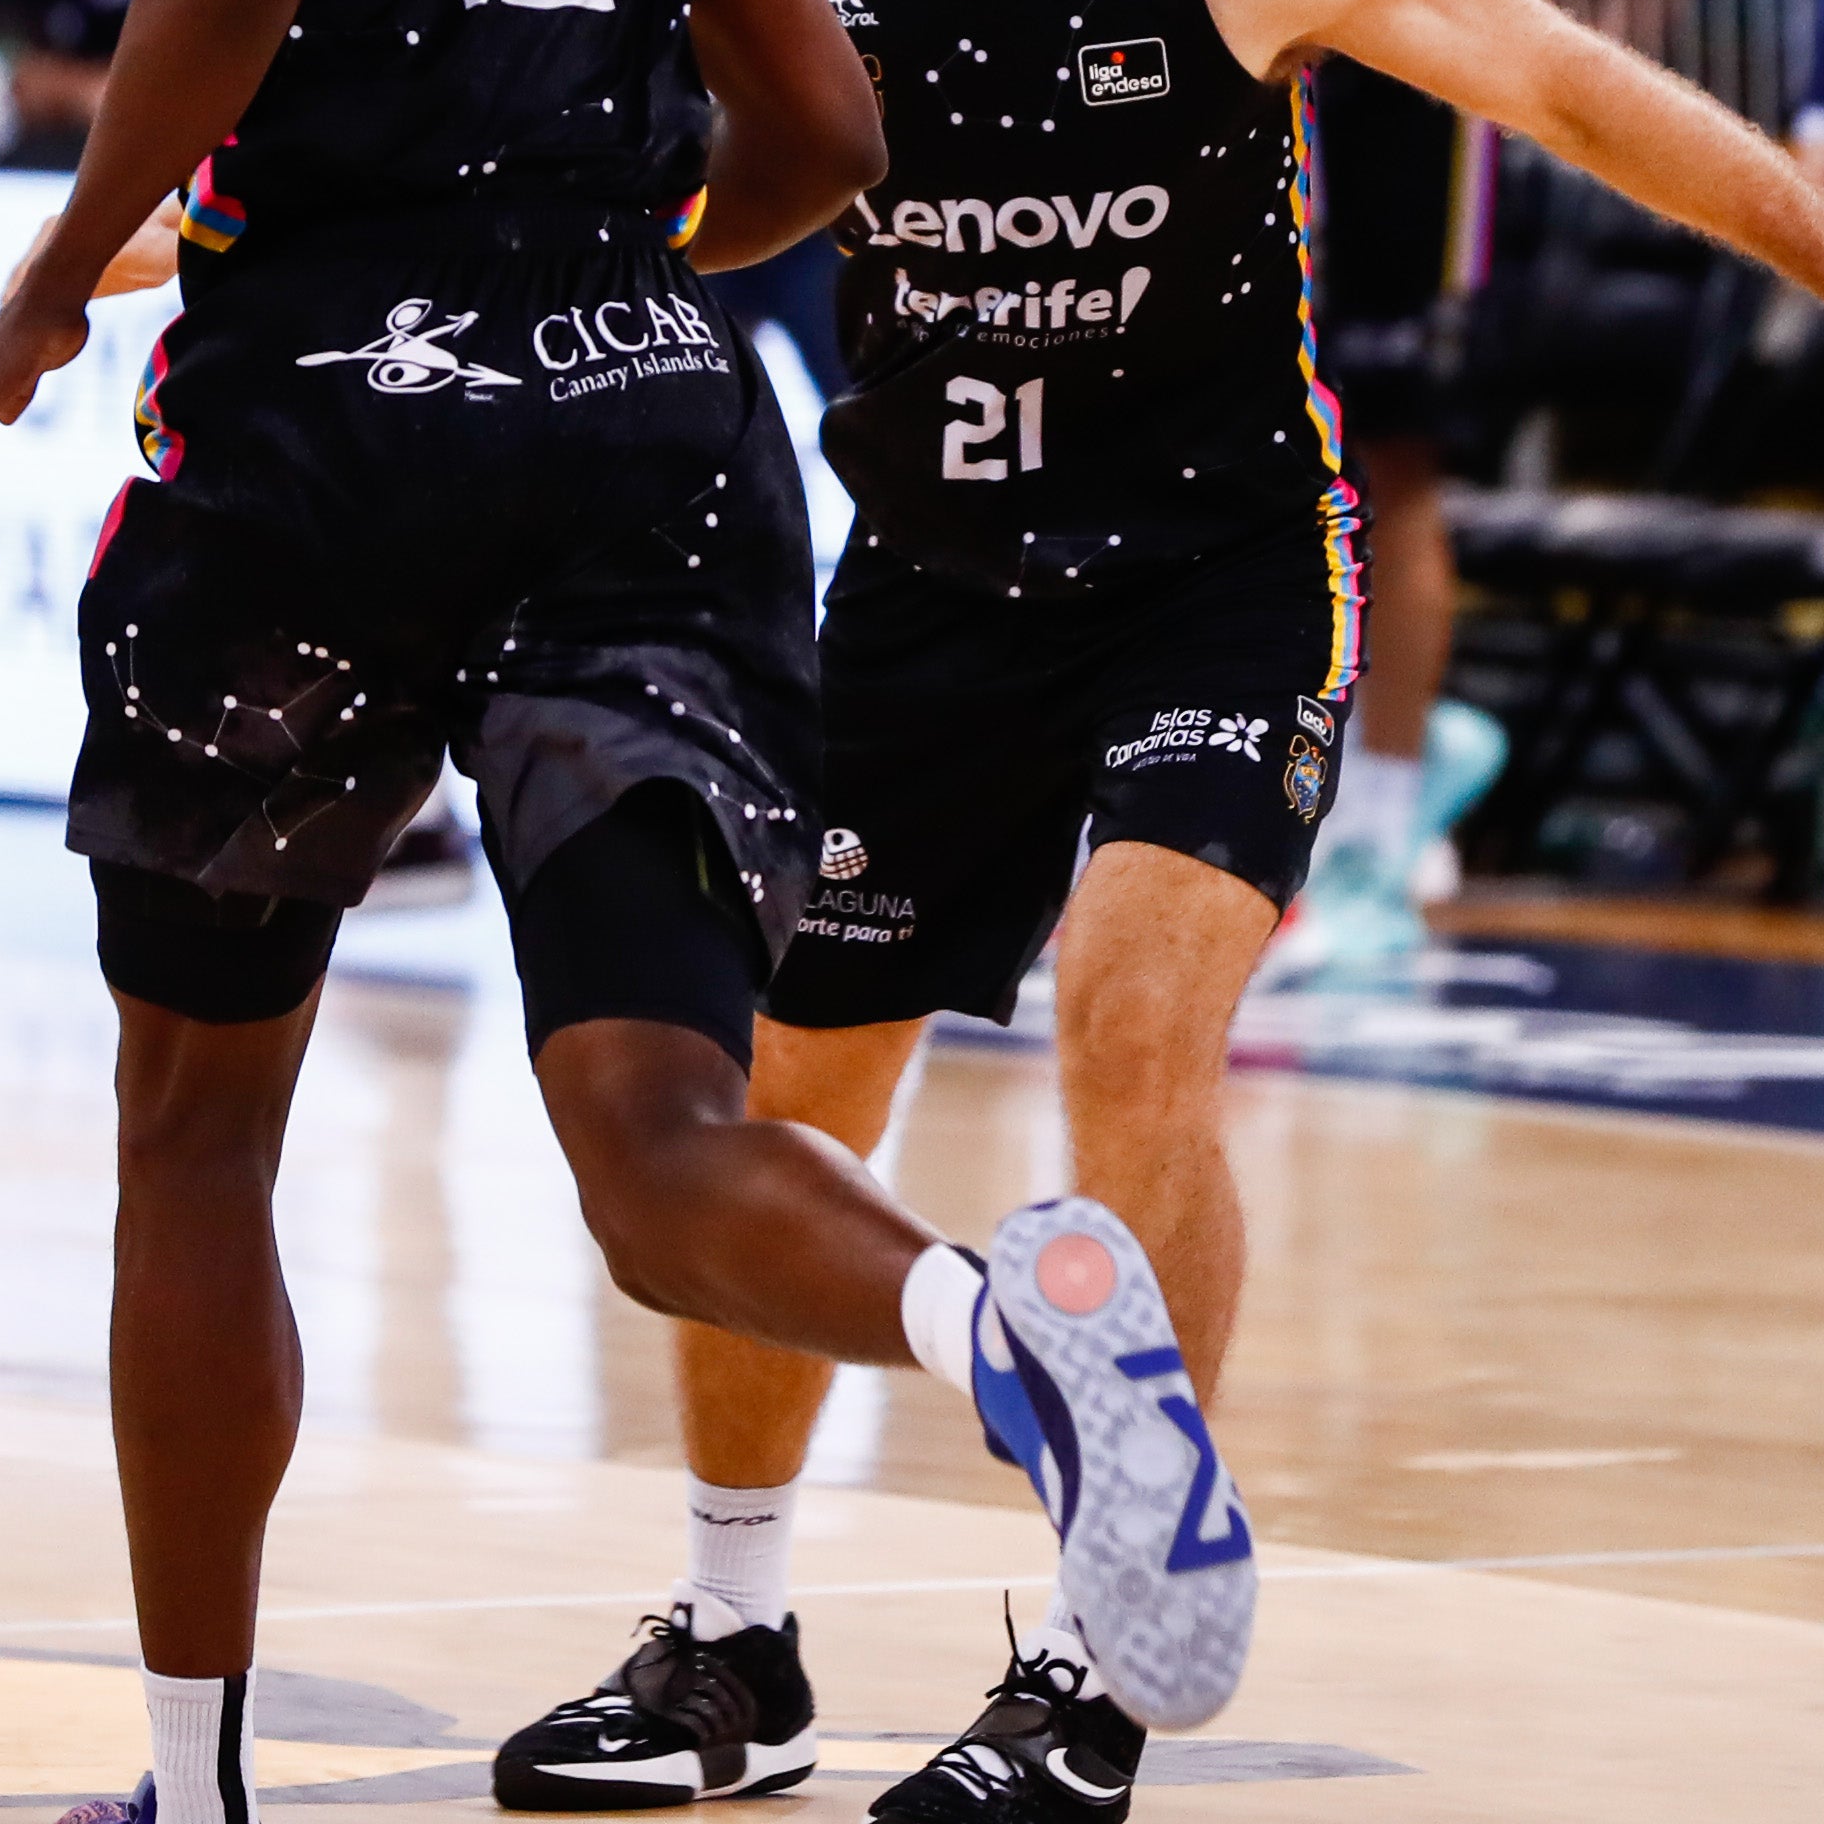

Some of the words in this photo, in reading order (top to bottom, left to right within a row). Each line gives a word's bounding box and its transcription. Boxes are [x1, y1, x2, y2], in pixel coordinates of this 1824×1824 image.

[1089, 63, 1123, 82] liga
[1092, 75, 1163, 96] endesa
[855, 184, 1170, 254] Lenovo
[533, 293, 719, 371] CICAR
[977, 325, 1110, 350] emociones
[550, 366, 628, 402] Canary
[631, 348, 702, 379] Islands
[943, 376, 1045, 479] 21
[1149, 708, 1212, 733] Islas
[1105, 727, 1205, 769] Canarias
[797, 917, 840, 937] orte
[843, 923, 893, 943] para
